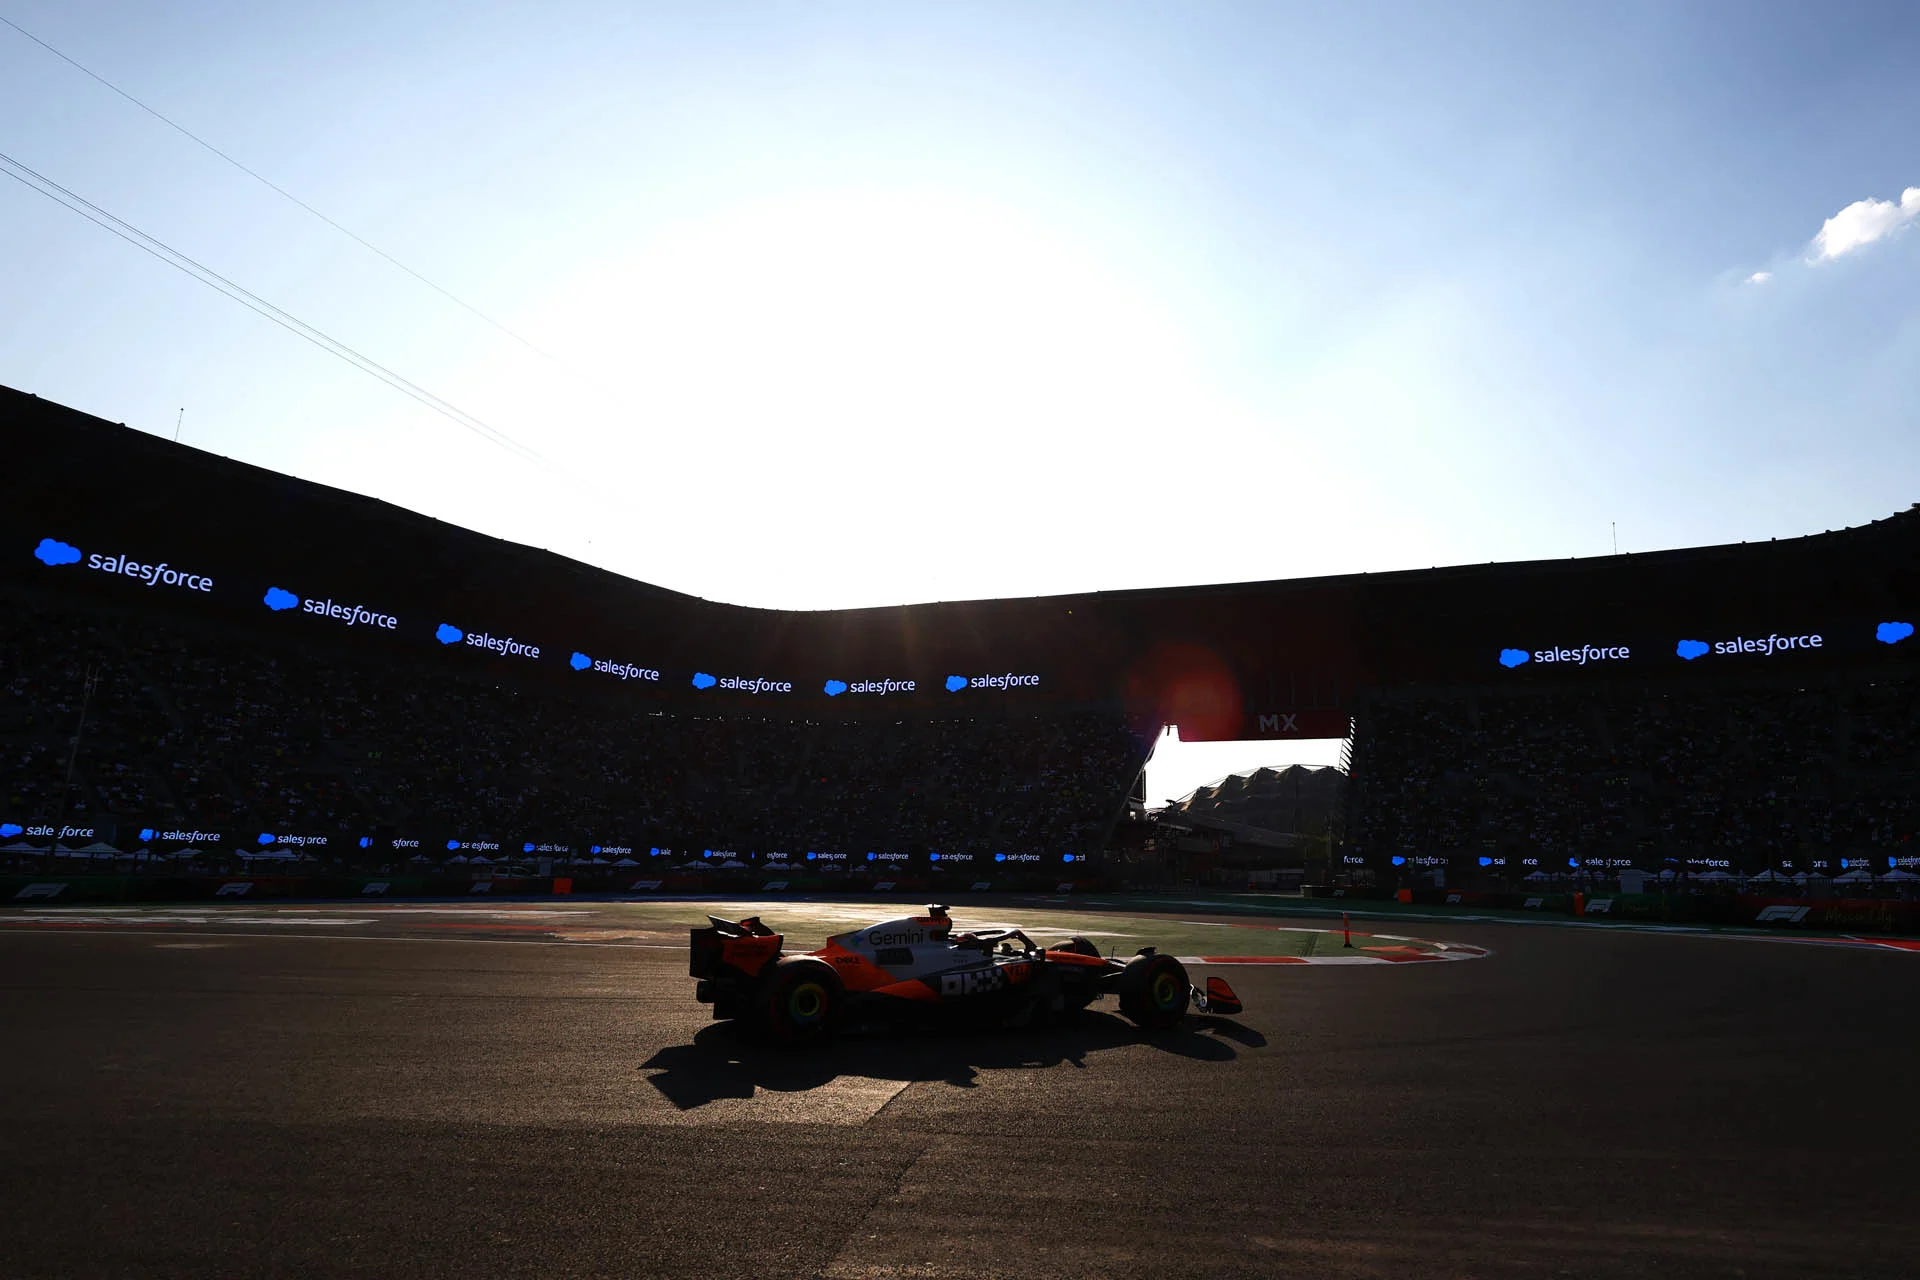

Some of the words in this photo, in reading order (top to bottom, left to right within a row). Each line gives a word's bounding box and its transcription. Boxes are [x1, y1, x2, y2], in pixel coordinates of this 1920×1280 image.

[87, 554, 213, 592] salesforce
[303, 599, 398, 630] salesforce
[466, 632, 540, 659] salesforce
[1714, 633, 1823, 656] salesforce
[1534, 644, 1630, 665] salesforce
[593, 659, 660, 681] salesforce
[719, 675, 792, 694] salesforce
[850, 678, 916, 696] salesforce
[970, 672, 1040, 691] salesforce
[1258, 713, 1299, 732] MX
[26, 825, 94, 839] saleforce
[162, 830, 220, 843] salesforce
[461, 841, 500, 852] saesforce
[601, 845, 632, 856] salesforce
[878, 851, 909, 862] salesforce
[1755, 905, 1812, 922] F1
[868, 929, 924, 946] Gemini
